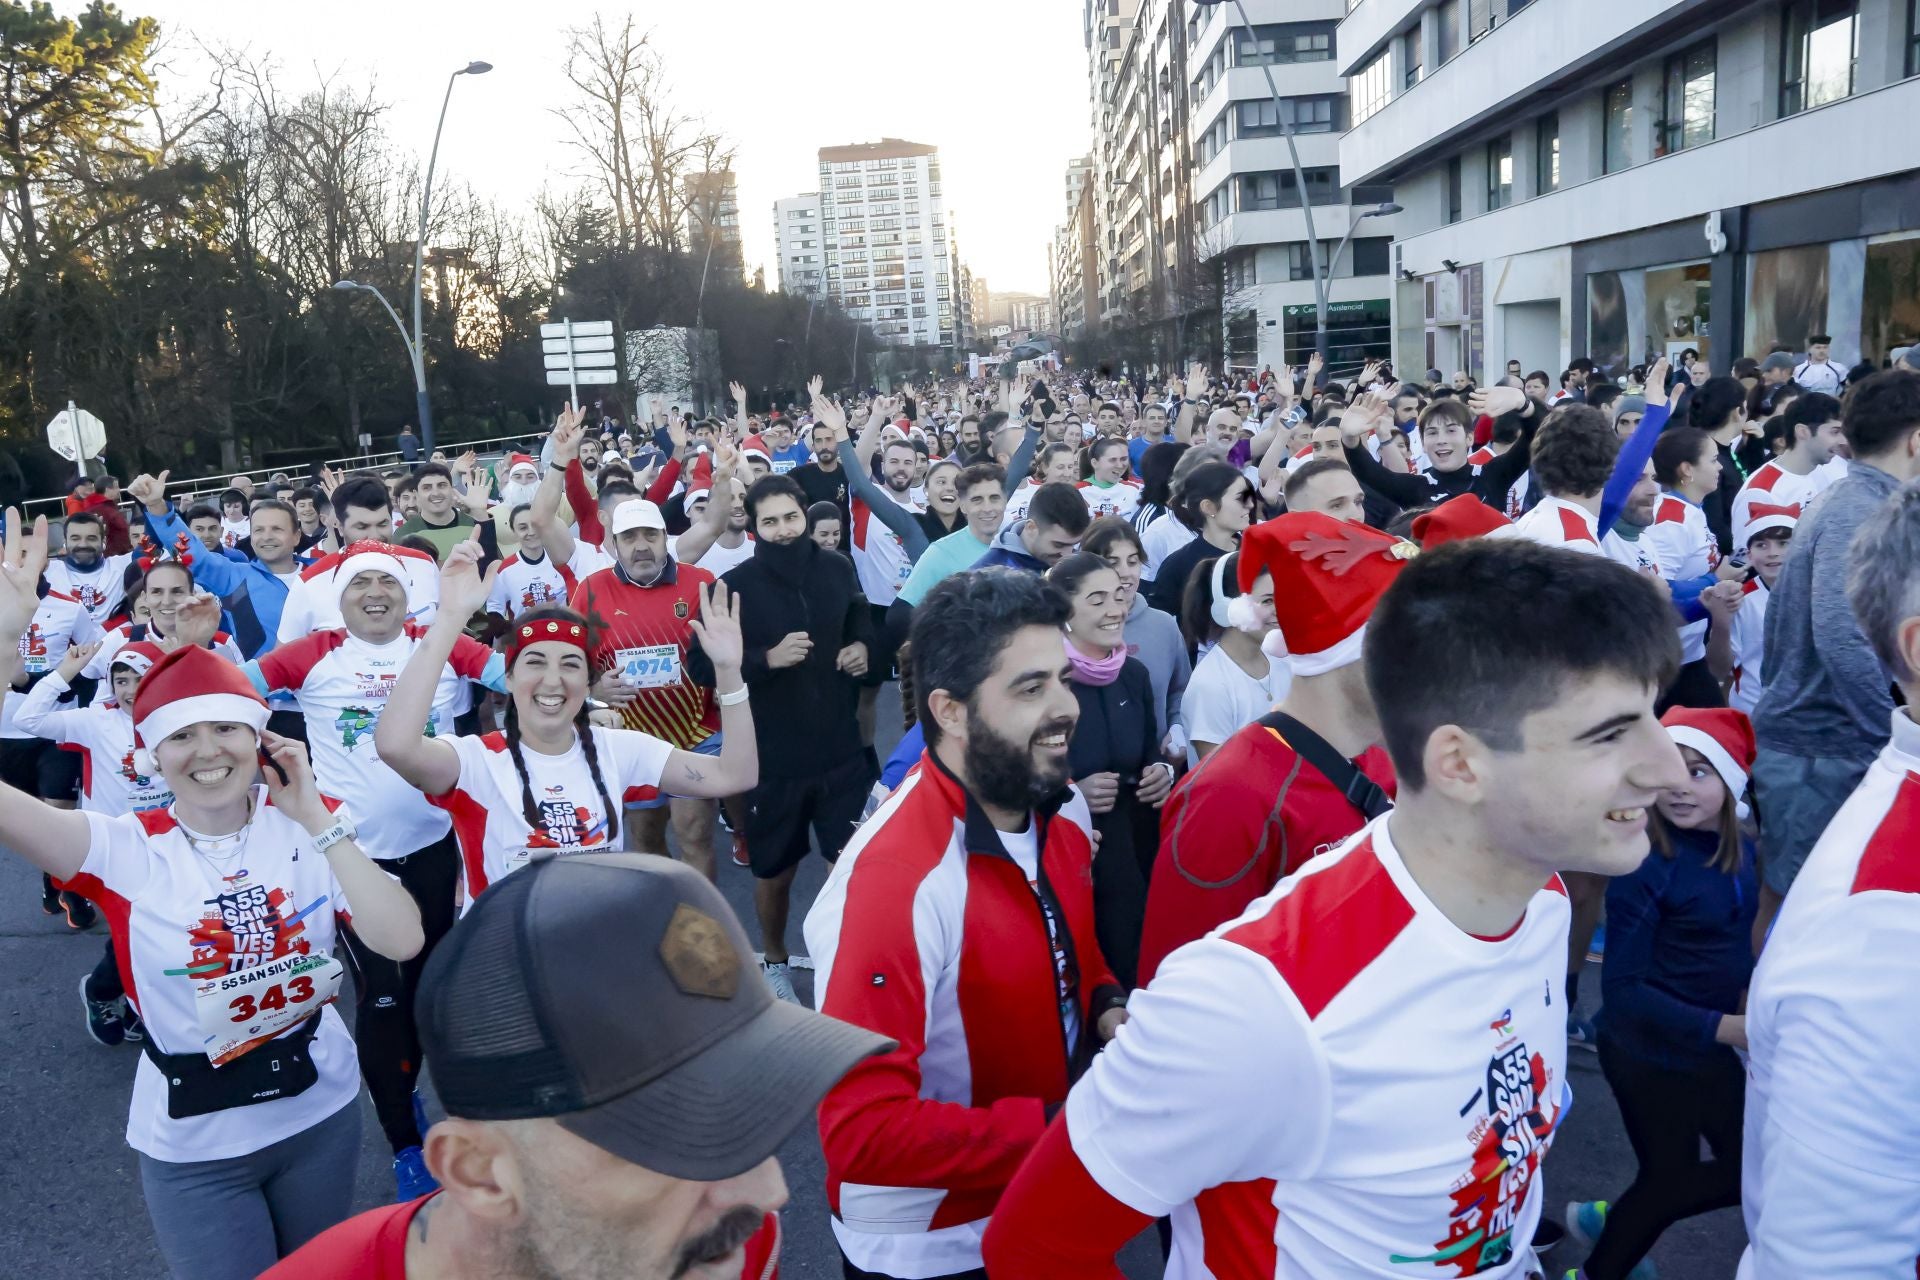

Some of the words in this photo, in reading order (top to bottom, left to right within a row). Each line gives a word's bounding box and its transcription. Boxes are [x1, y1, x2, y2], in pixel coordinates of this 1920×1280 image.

[1328, 302, 1364, 312] Asistencial
[625, 657, 673, 676] 4974
[544, 812, 578, 828] SAN
[553, 803, 575, 816] 55
[548, 827, 581, 843] SIL
[236, 887, 267, 910] 55
[223, 904, 270, 927] SAN
[233, 931, 276, 953] VES
[221, 977, 239, 990] 55
[239, 968, 267, 985] SAN
[228, 976, 316, 1023] 343
[1503, 1049, 1533, 1090] 55
[1495, 1084, 1534, 1127] SAN
[1502, 1116, 1538, 1167] SIL
